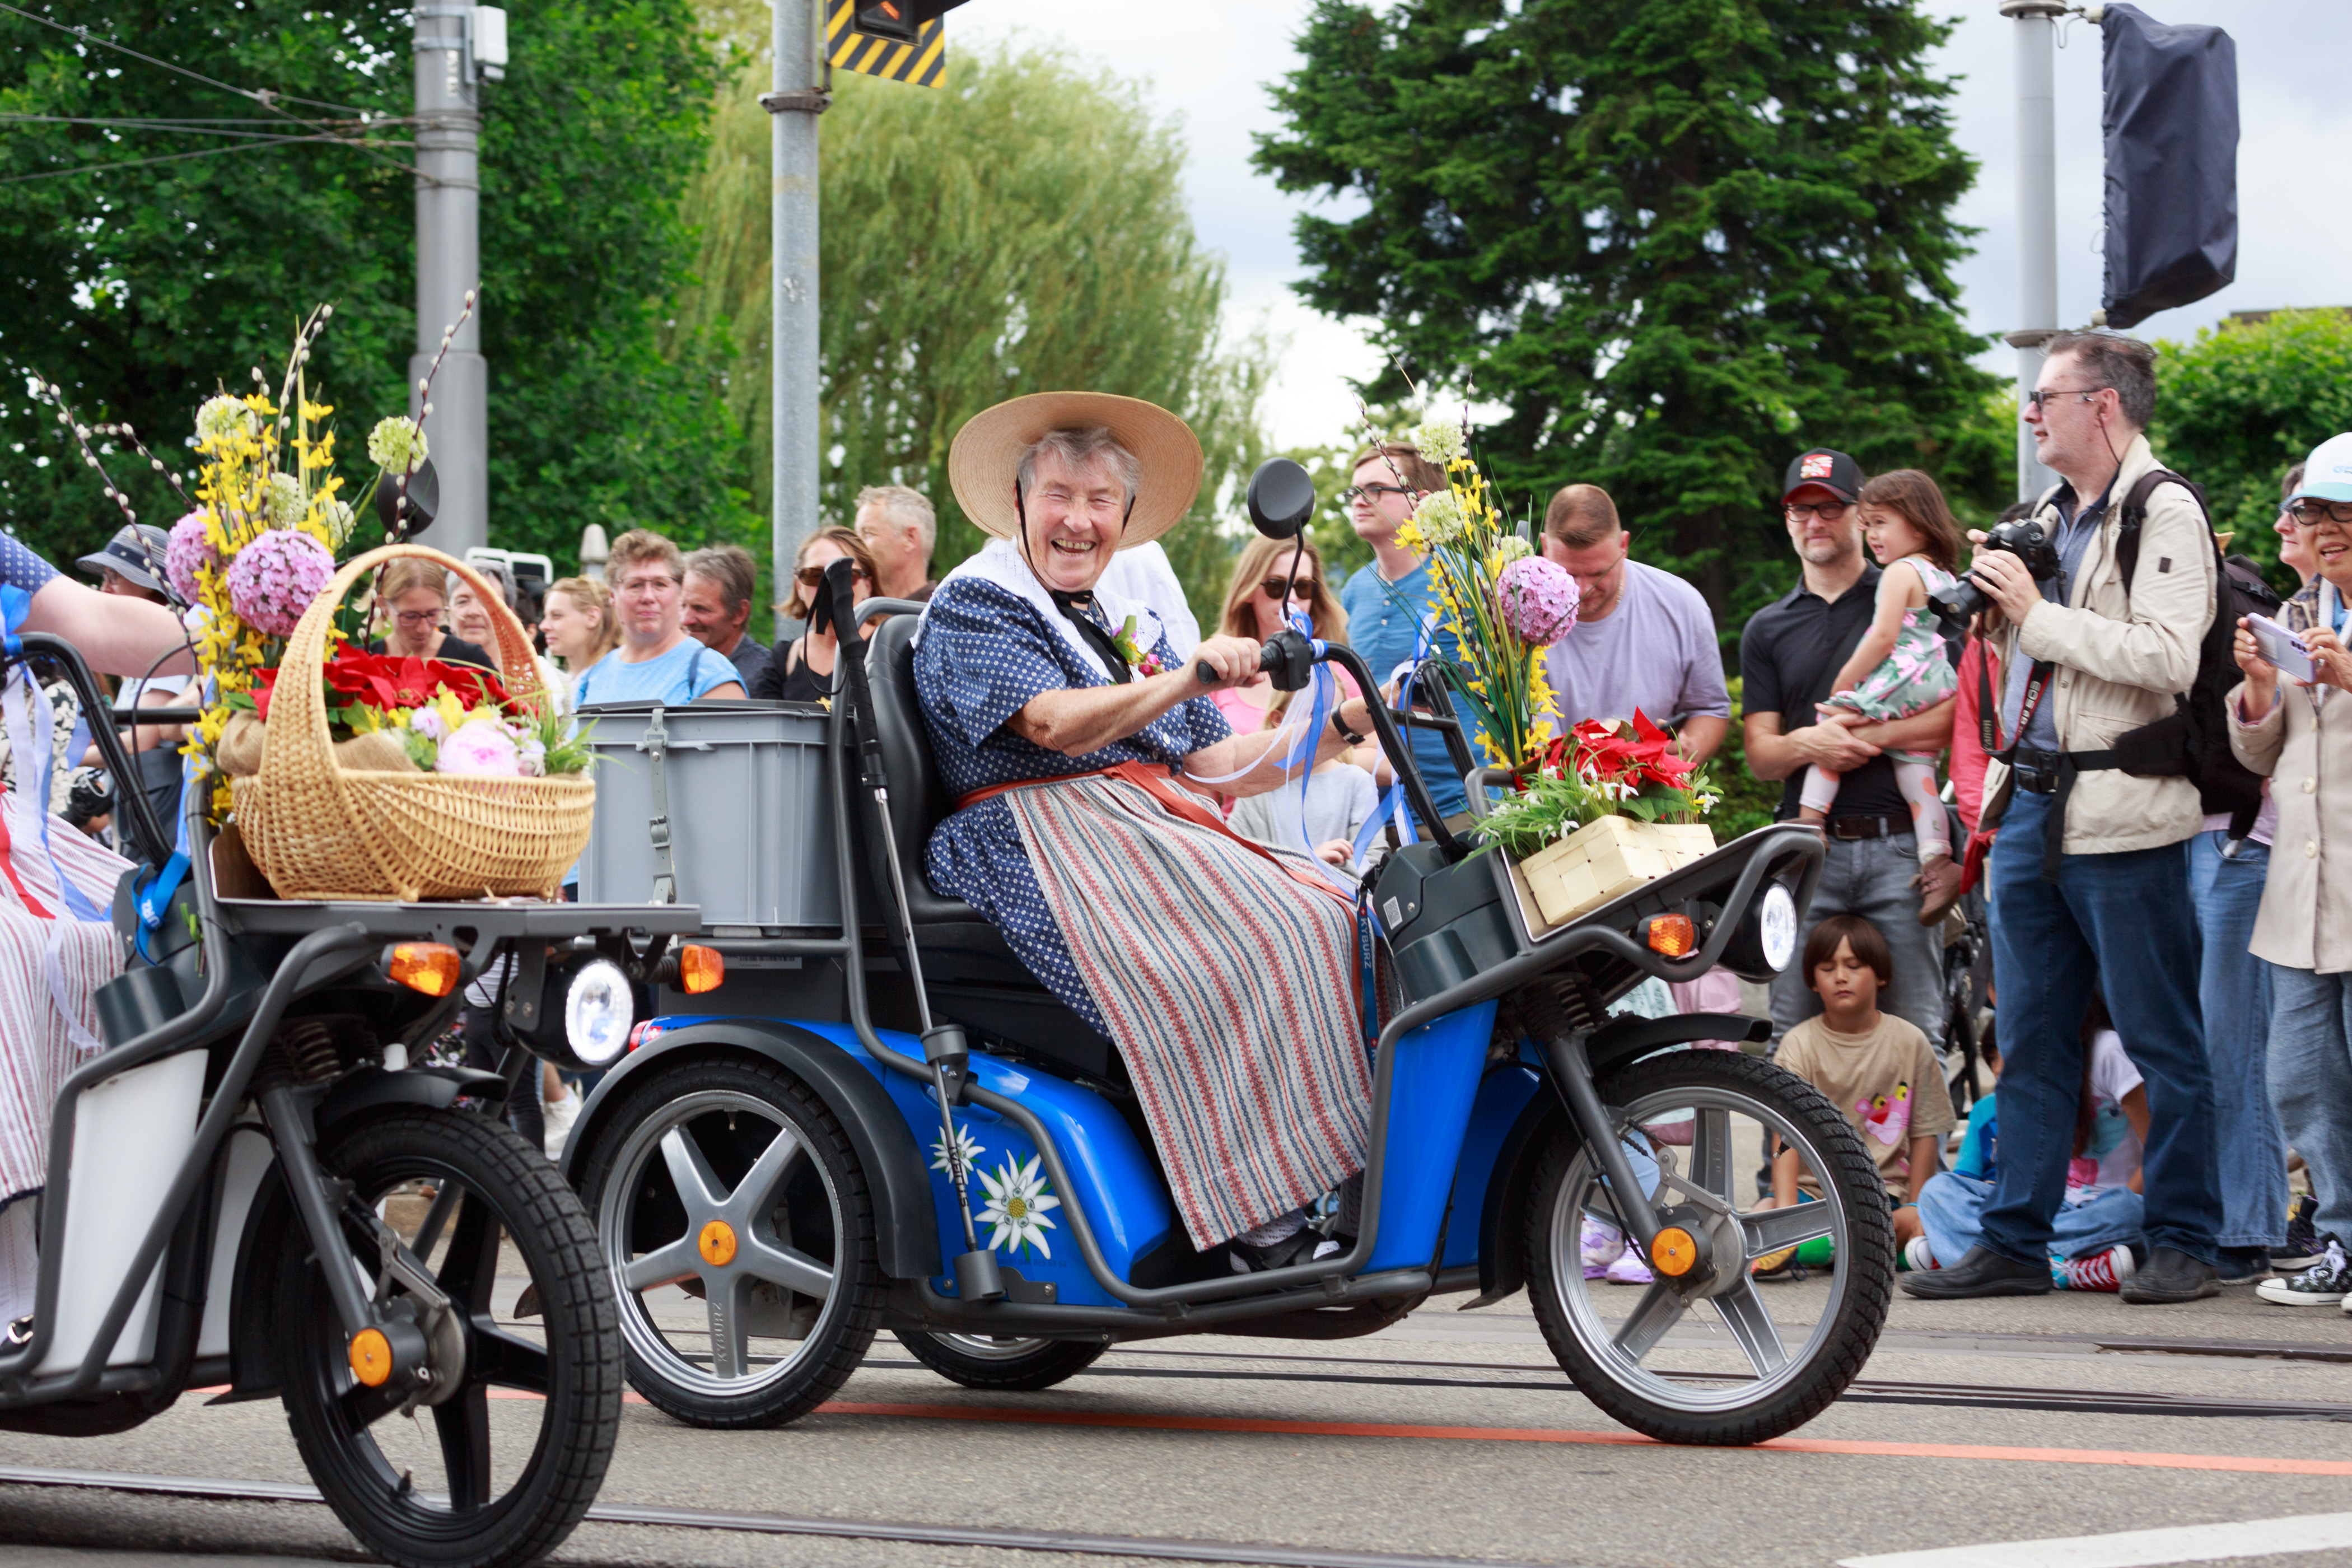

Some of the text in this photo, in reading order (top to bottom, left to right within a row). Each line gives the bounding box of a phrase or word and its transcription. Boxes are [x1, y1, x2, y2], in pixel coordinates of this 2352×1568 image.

[2025, 680, 2041, 709] EOS
[1983, 720, 1993, 751] Canon
[1361, 918, 1371, 969] KYBURZ
[949, 1146, 969, 1207] STUBAI
[712, 1302, 727, 1362] KYBURZ
